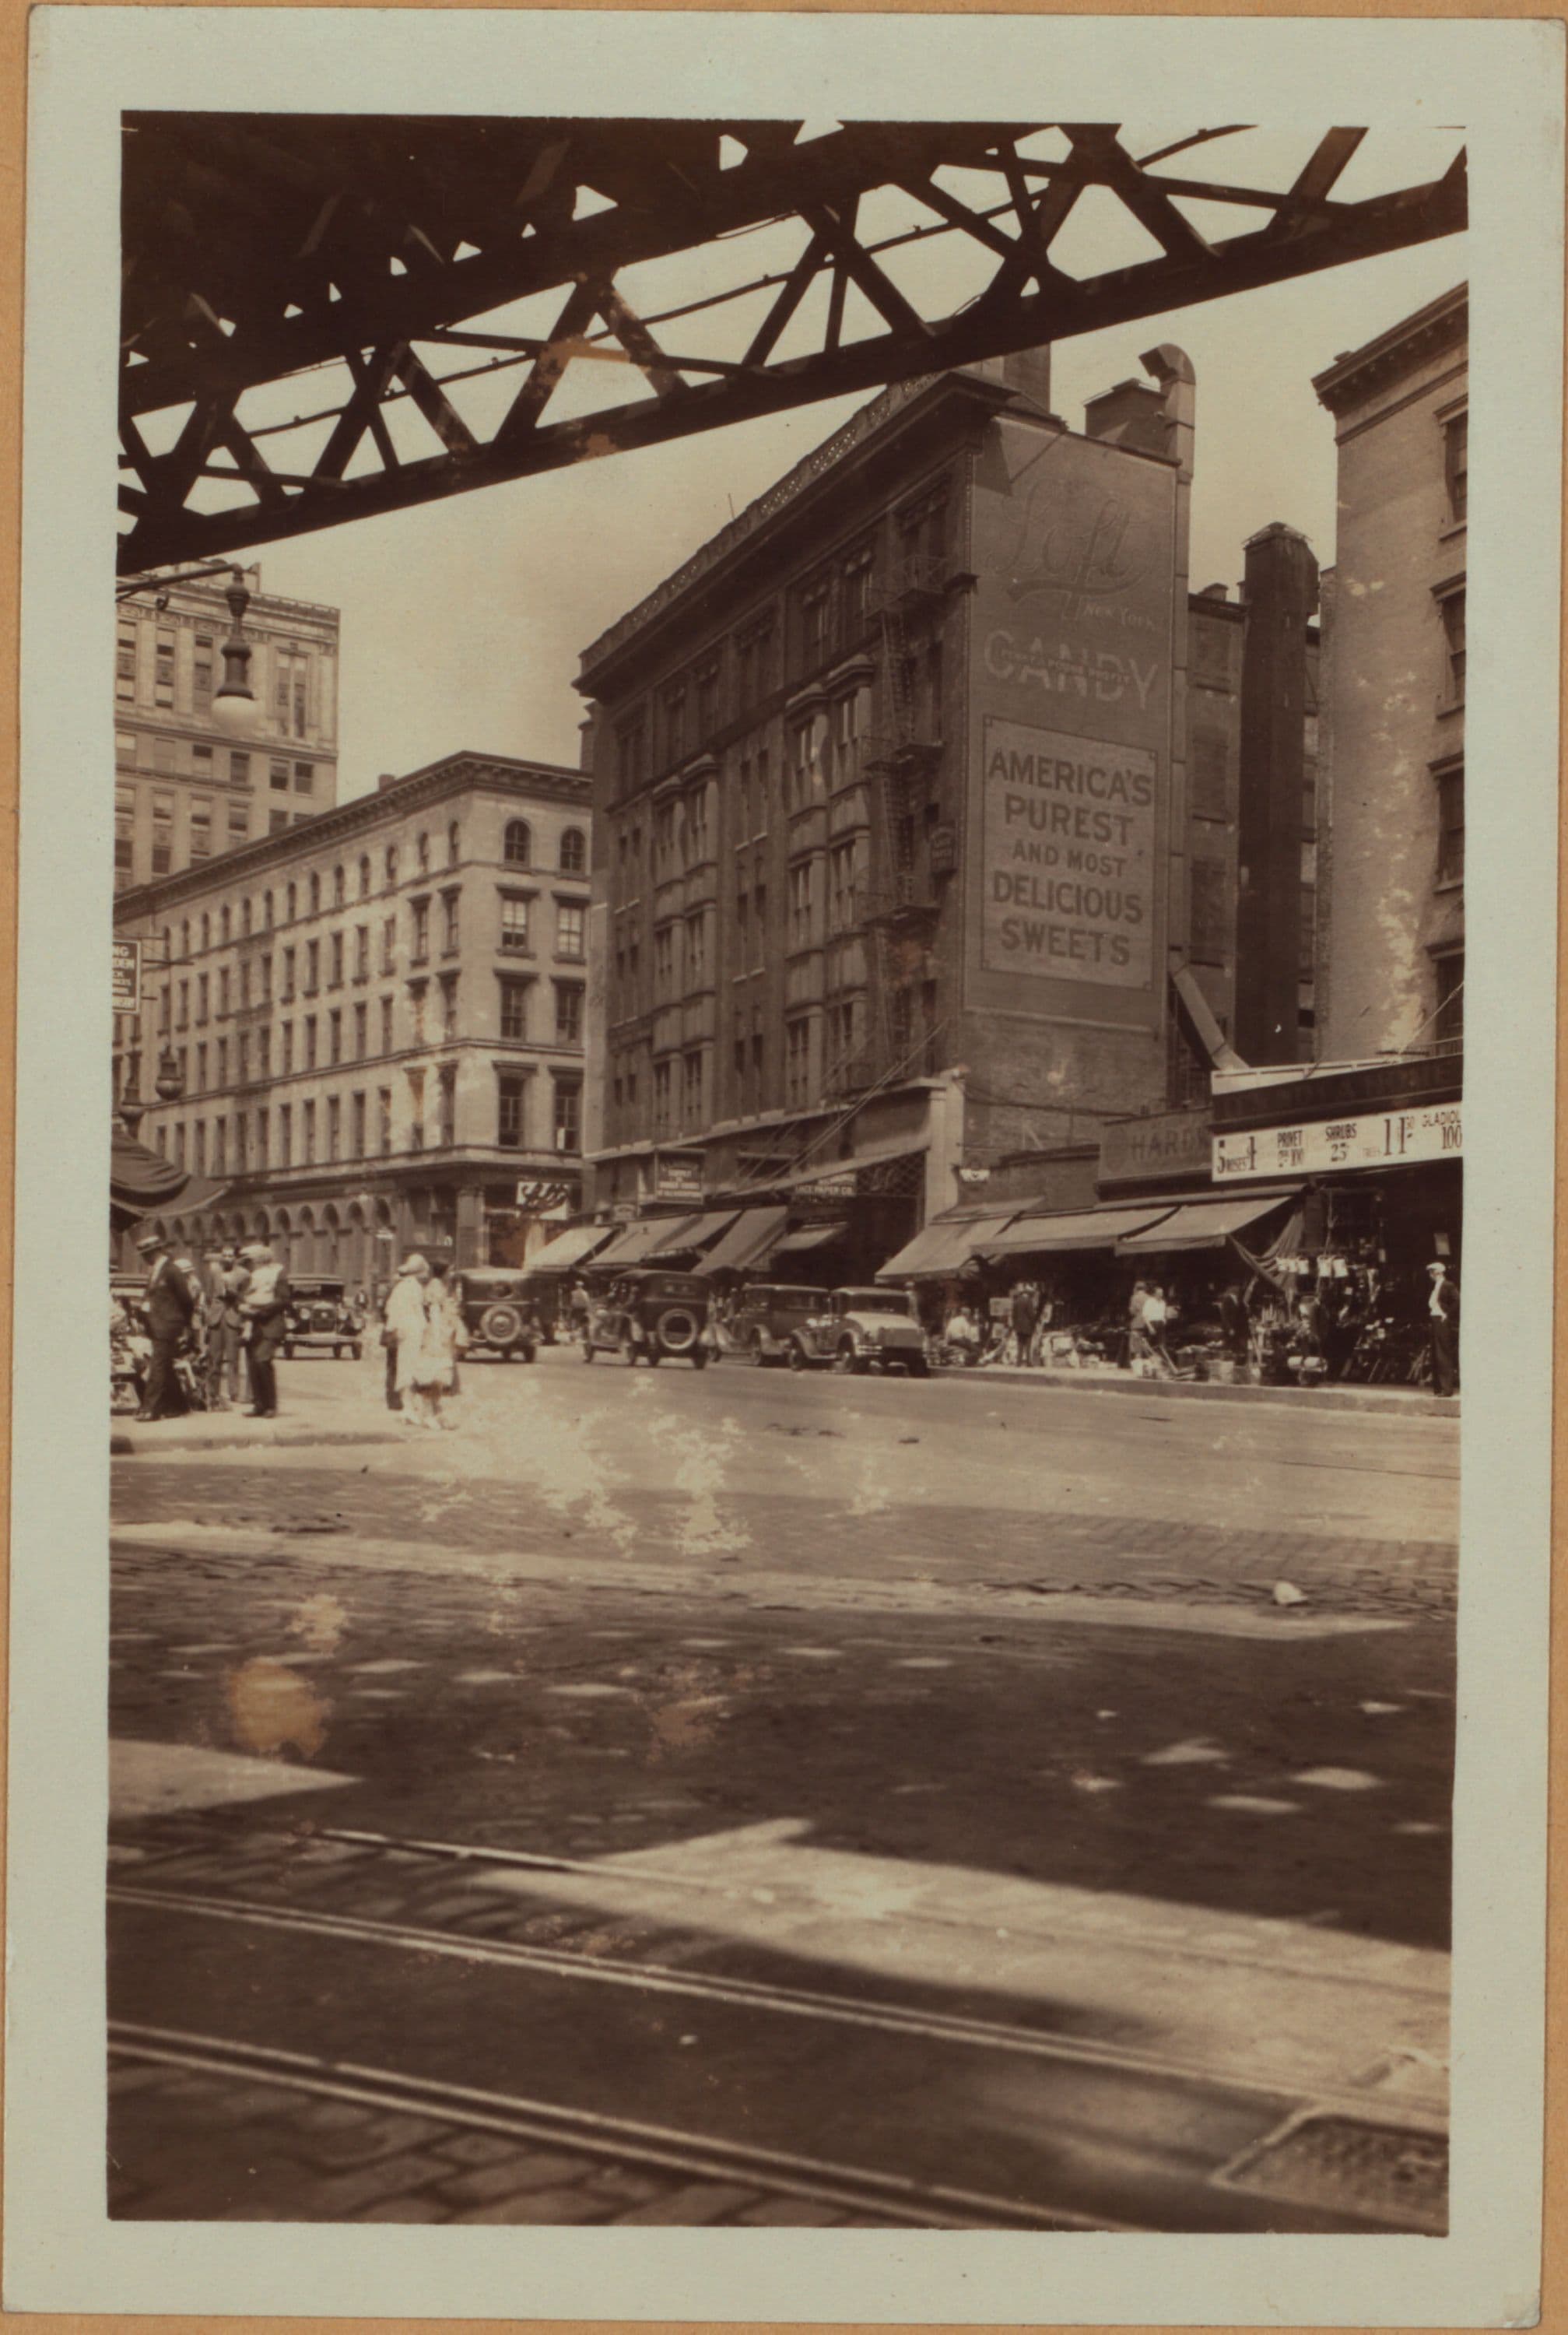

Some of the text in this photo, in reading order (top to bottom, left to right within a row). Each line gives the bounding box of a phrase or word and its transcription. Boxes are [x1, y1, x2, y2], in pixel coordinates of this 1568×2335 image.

[984, 630, 1159, 710] CANDY
[989, 750, 1152, 806] AMERICA'S
[1005, 794, 1134, 846] PUREST
[1012, 839, 1127, 877] AND MOST
[993, 871, 1143, 924] DELICIOUS
[1001, 918, 1131, 966] SWEETS
